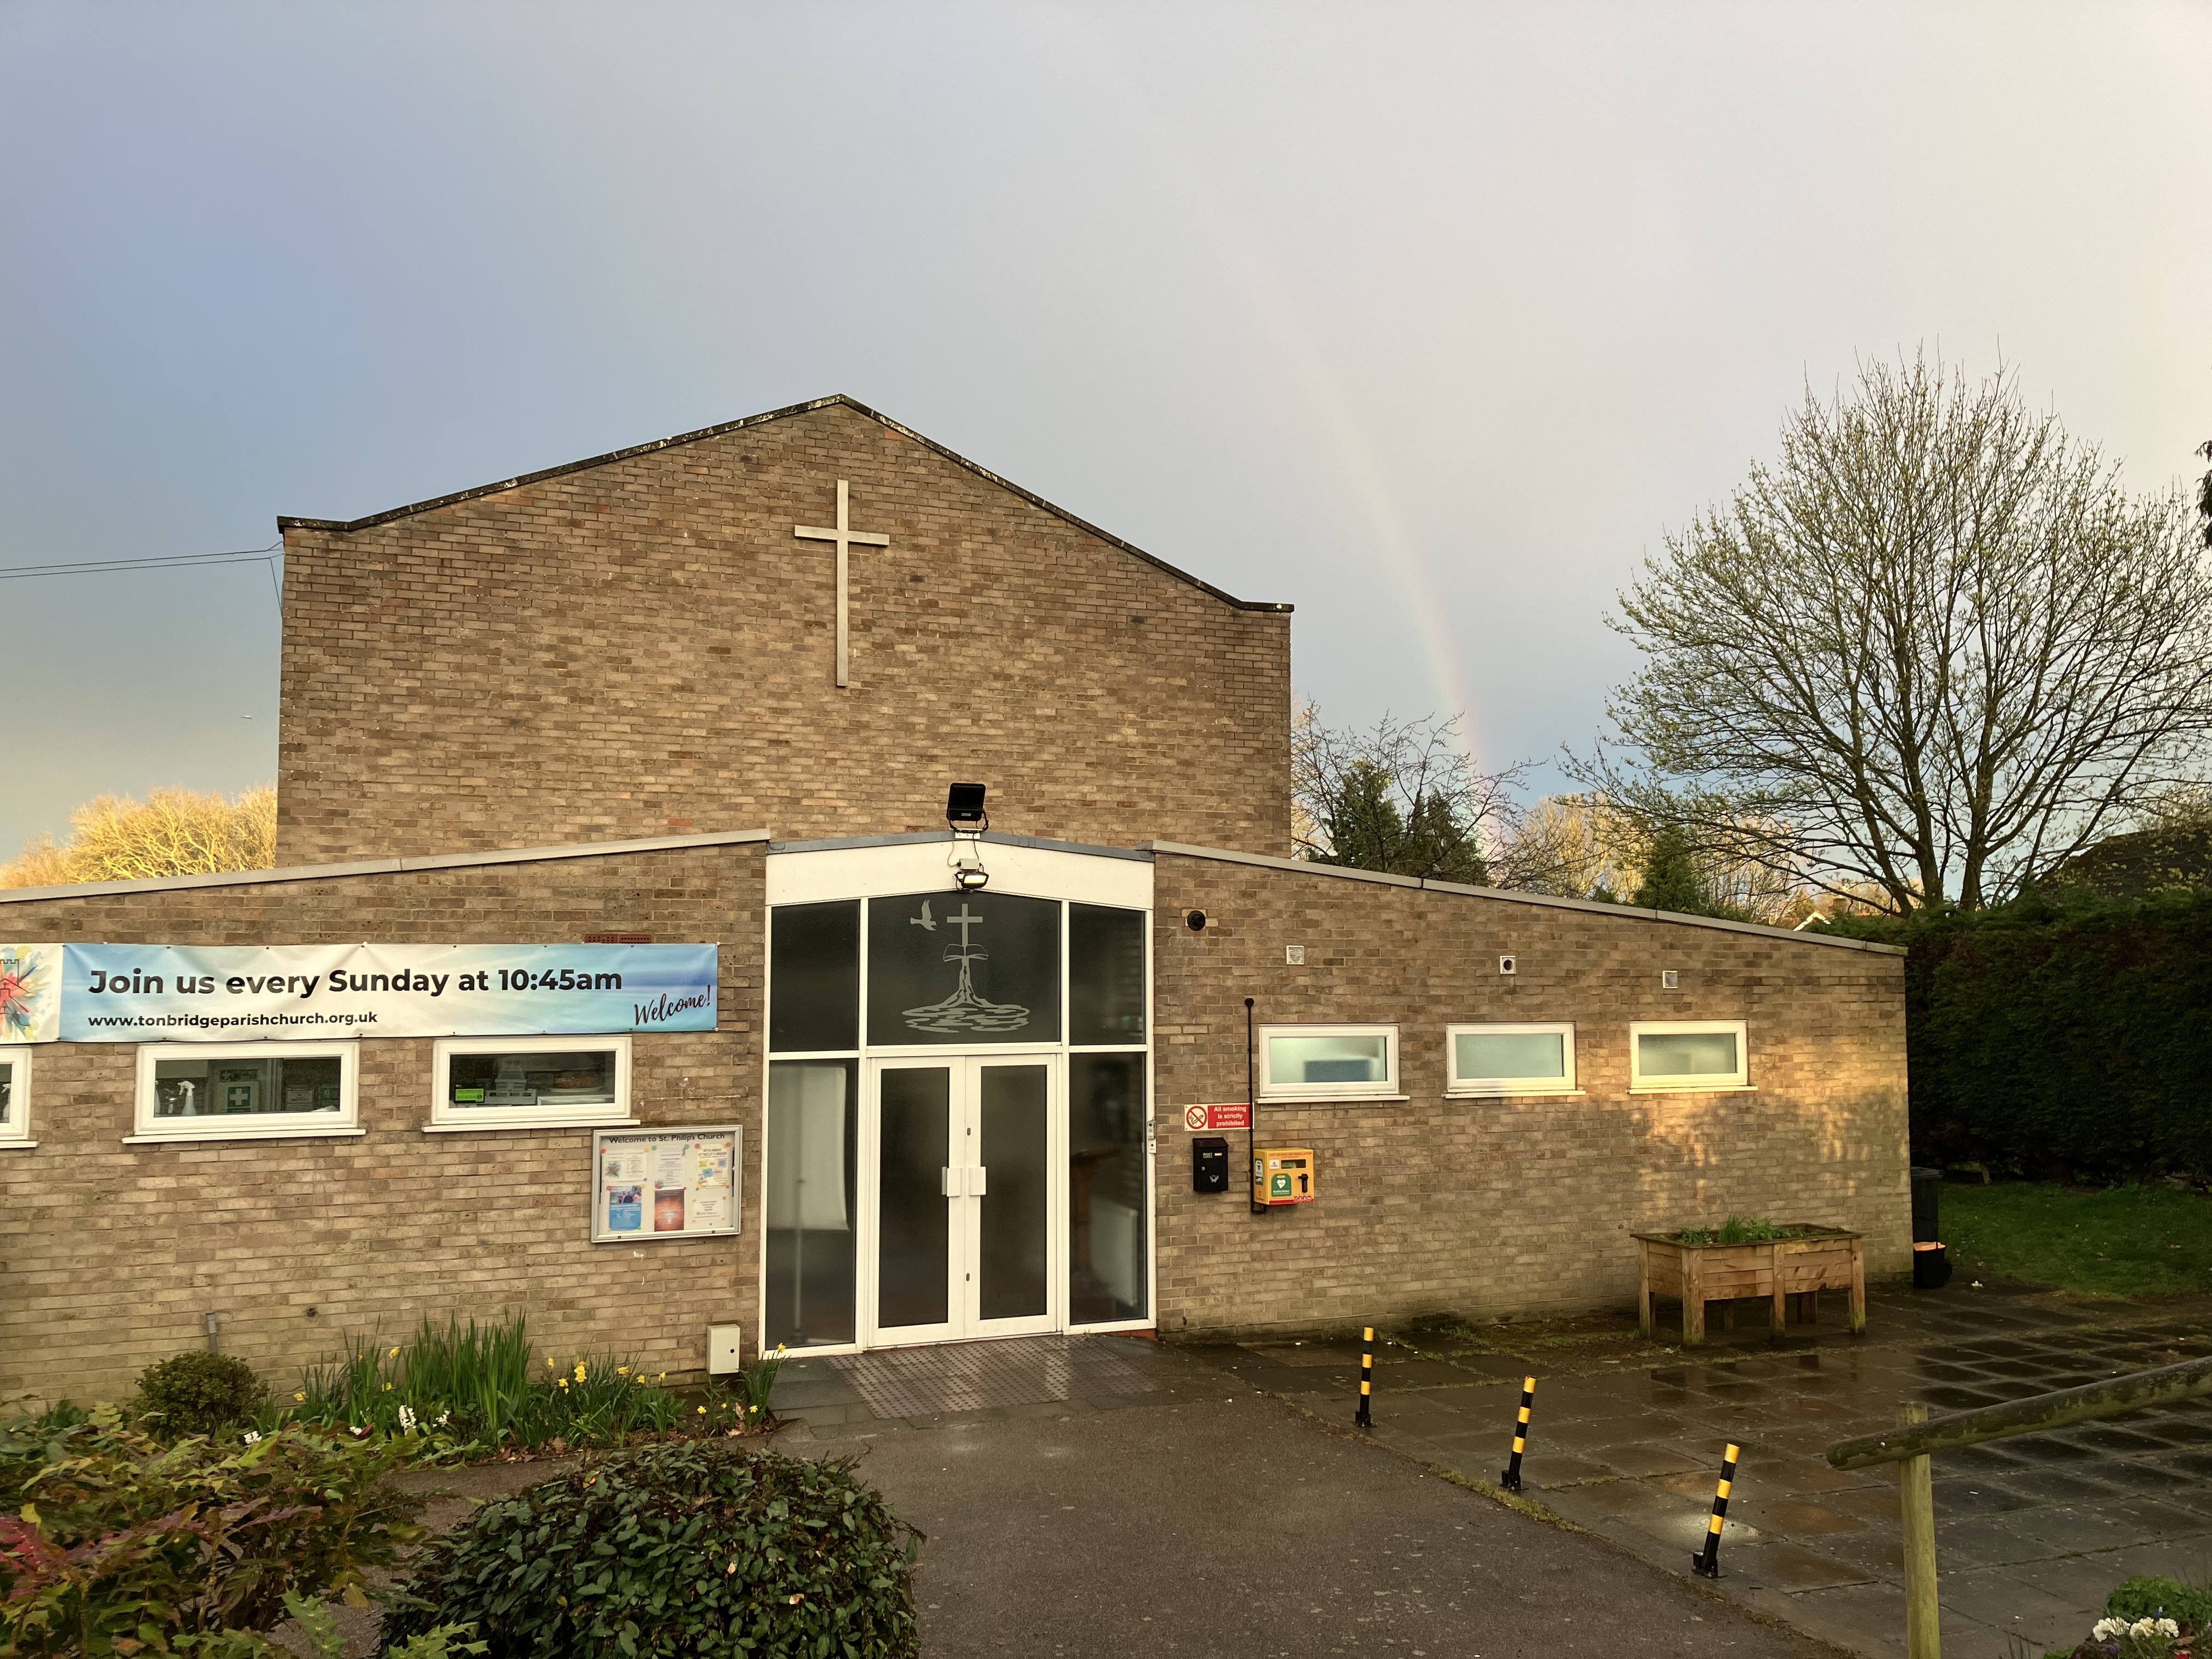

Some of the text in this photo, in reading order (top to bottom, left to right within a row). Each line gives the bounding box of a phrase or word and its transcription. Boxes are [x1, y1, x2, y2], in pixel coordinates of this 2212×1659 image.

[88, 968, 622, 998] Join us every Sunday at 10:45am
[634, 984, 711, 1026] Welcome!
[88, 1012, 377, 1029] www.tonbridgeparishchurch.org.uk
[1216, 1120, 1245, 1128] prohibited
[671, 1133, 696, 1142] Philip's
[697, 1132, 725, 1141] Church
